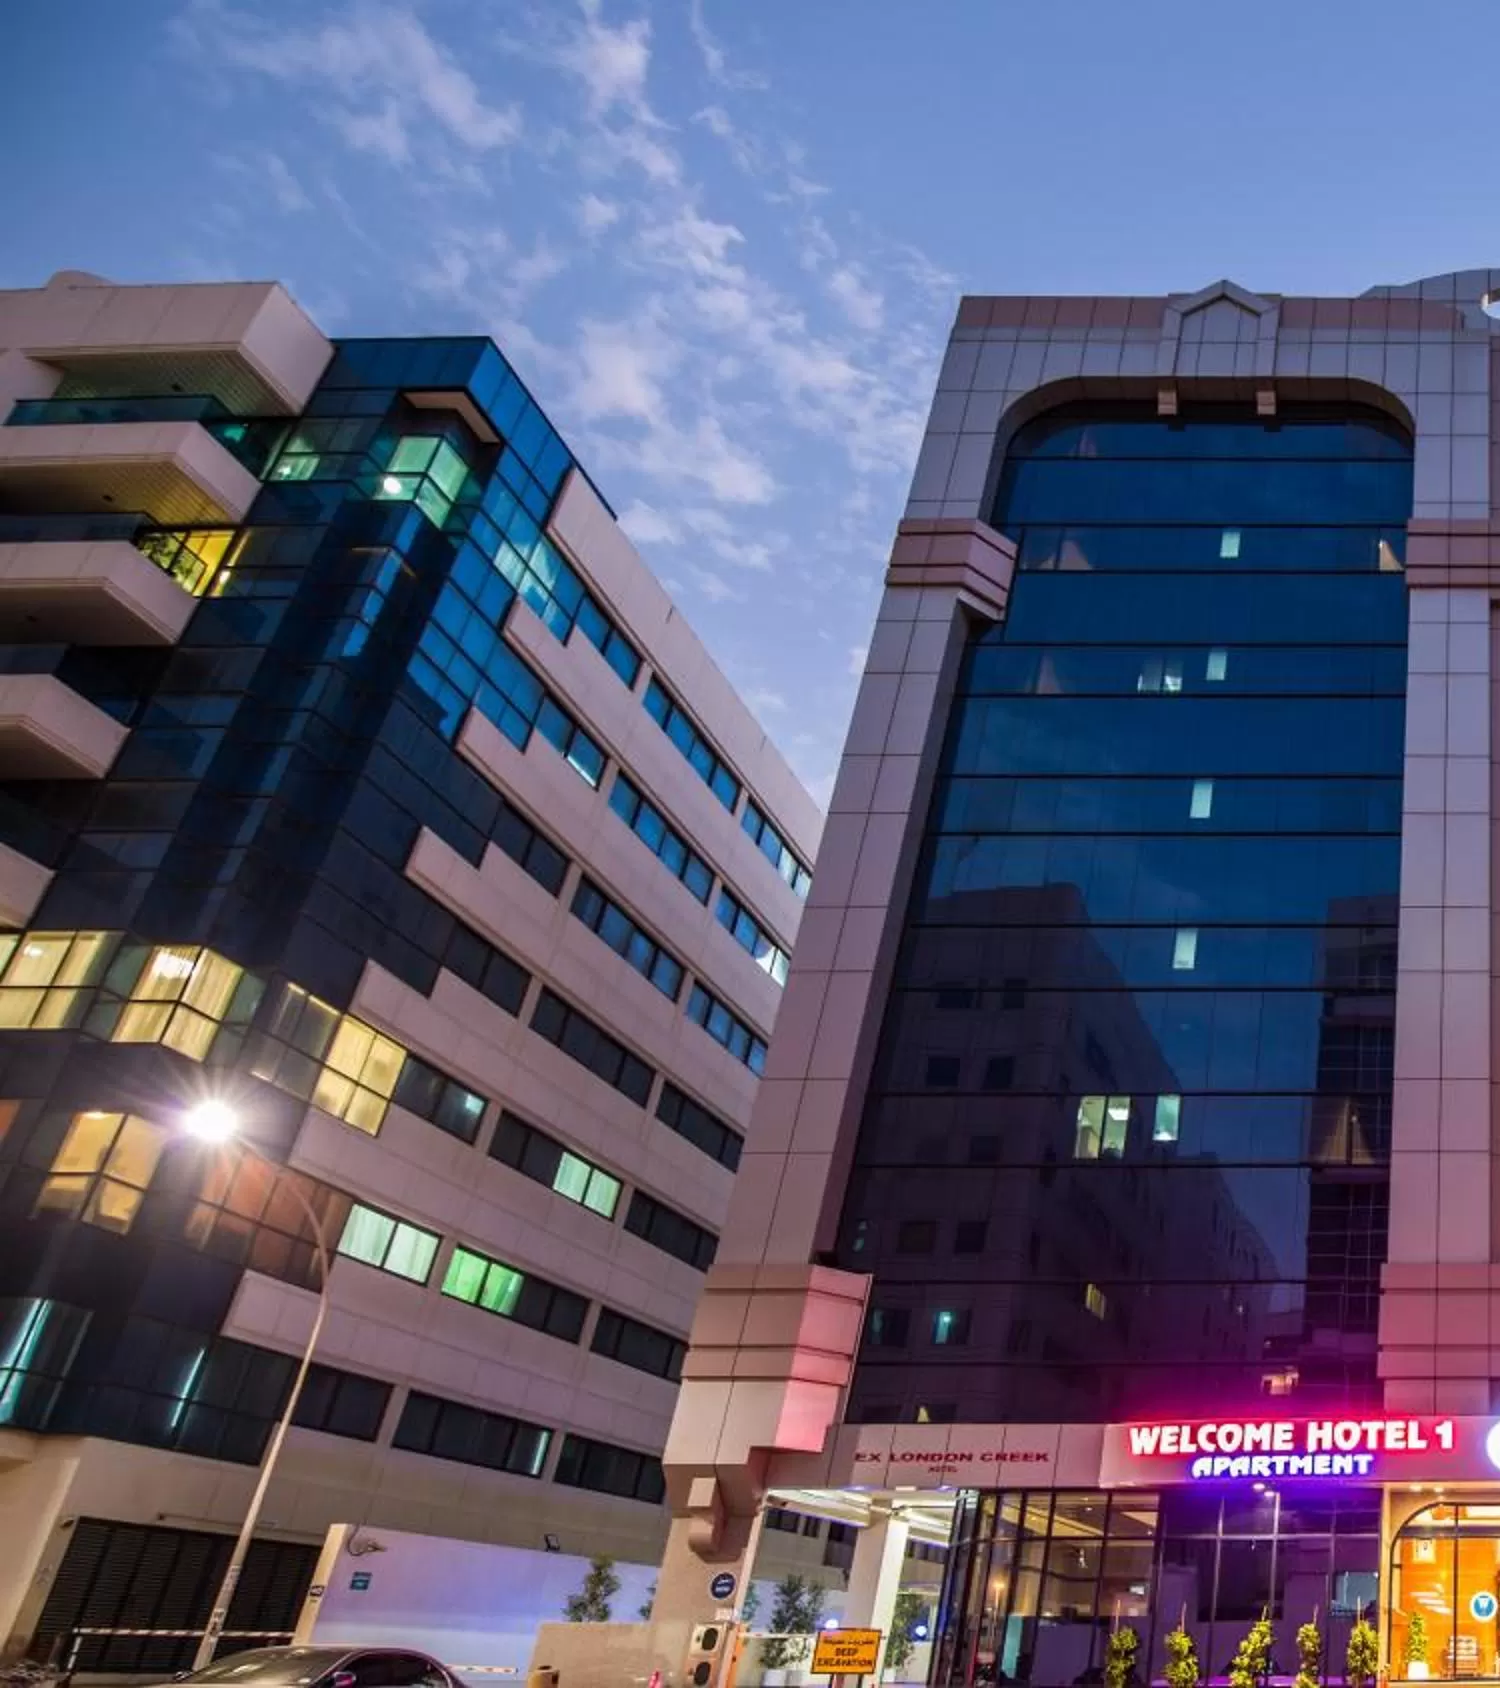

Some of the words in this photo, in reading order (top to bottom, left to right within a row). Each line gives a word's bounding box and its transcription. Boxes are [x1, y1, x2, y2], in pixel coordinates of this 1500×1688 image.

[1129, 1422, 1295, 1455] WELCOME
[1307, 1420, 1427, 1452] HOTEL
[1435, 1420, 1453, 1449] 1
[853, 1452, 882, 1463] EX
[888, 1452, 974, 1463] LONDON
[979, 1452, 1050, 1463] CREEK
[1191, 1454, 1374, 1478] APARTMENT
